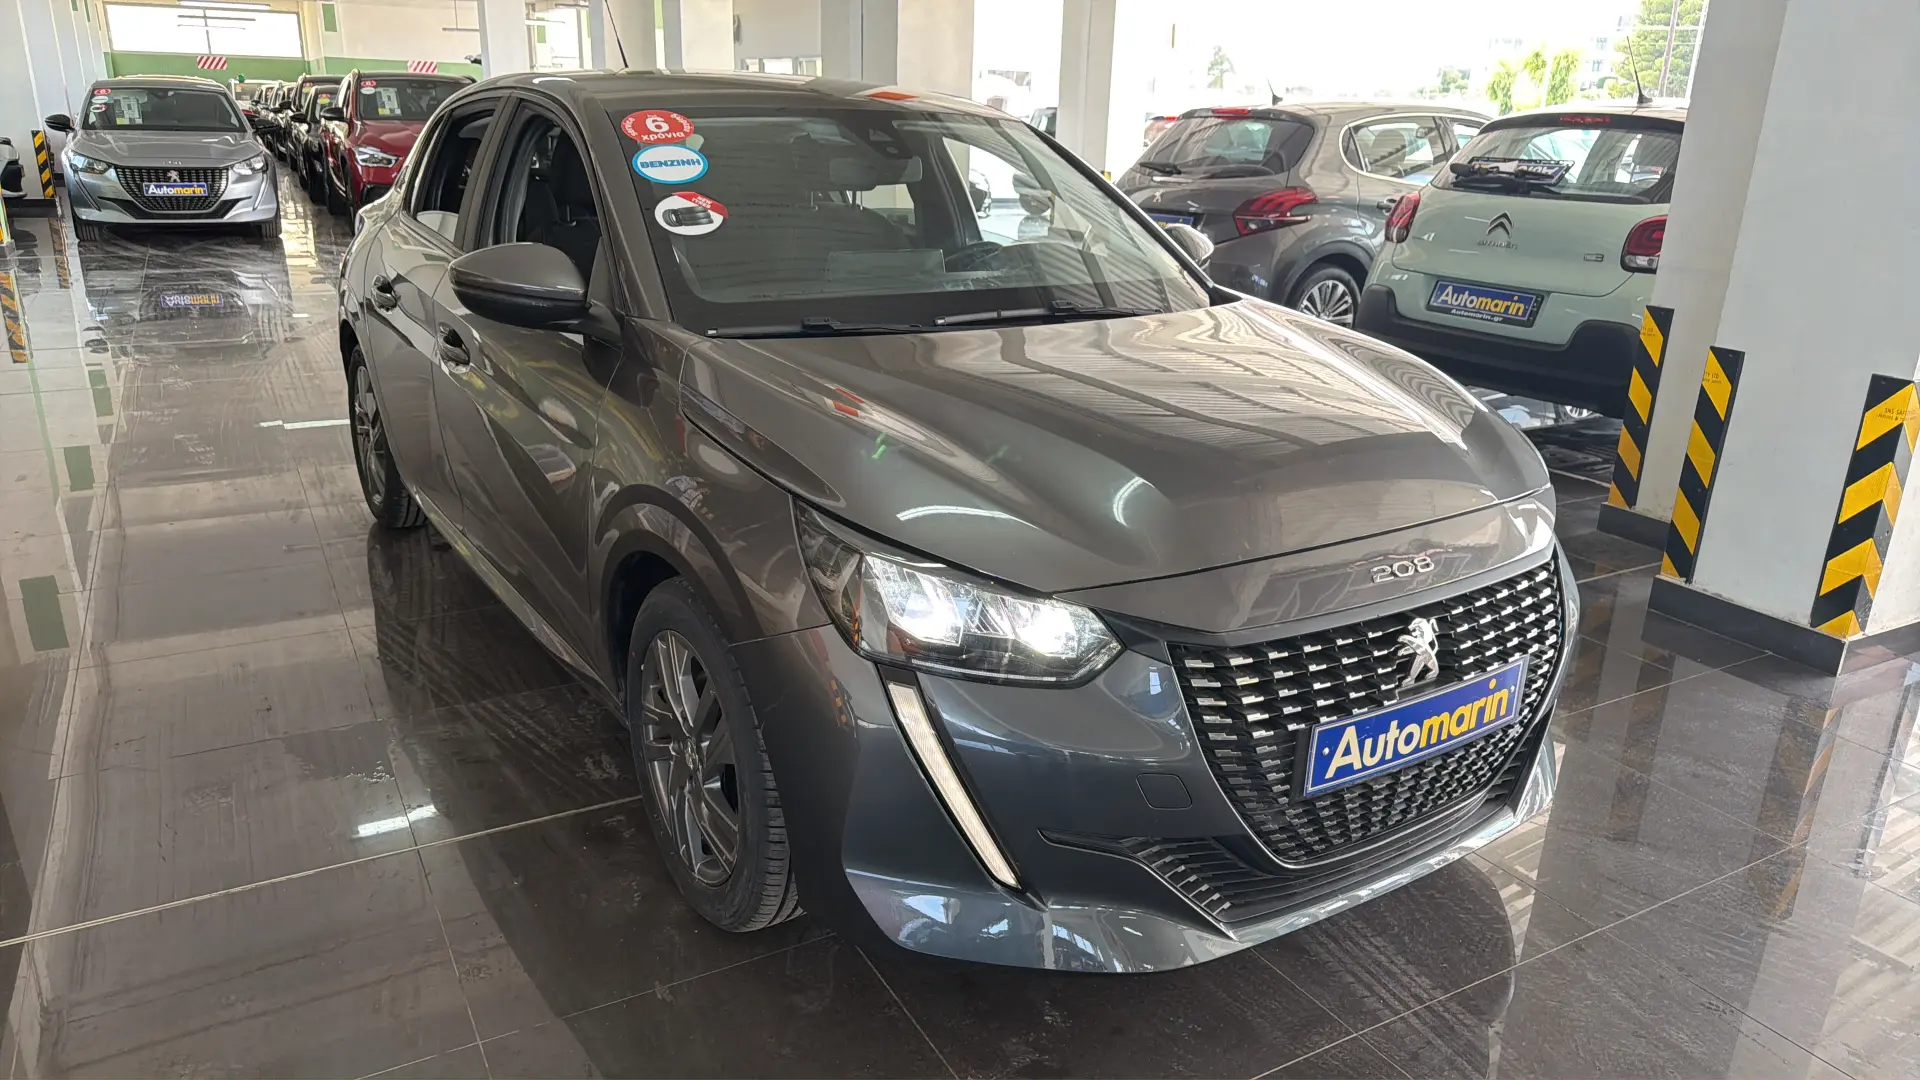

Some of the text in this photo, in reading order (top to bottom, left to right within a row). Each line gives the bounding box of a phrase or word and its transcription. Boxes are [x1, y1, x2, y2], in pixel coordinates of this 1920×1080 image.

[645, 116, 670, 133] 6
[641, 131, 685, 141] χρόνια
[148, 184, 204, 194] Automarin
[1438, 285, 1526, 317] Automarin
[1450, 308, 1504, 323] Automarin.gr
[1370, 556, 1435, 584] 208
[1324, 677, 1509, 780] Automarin
